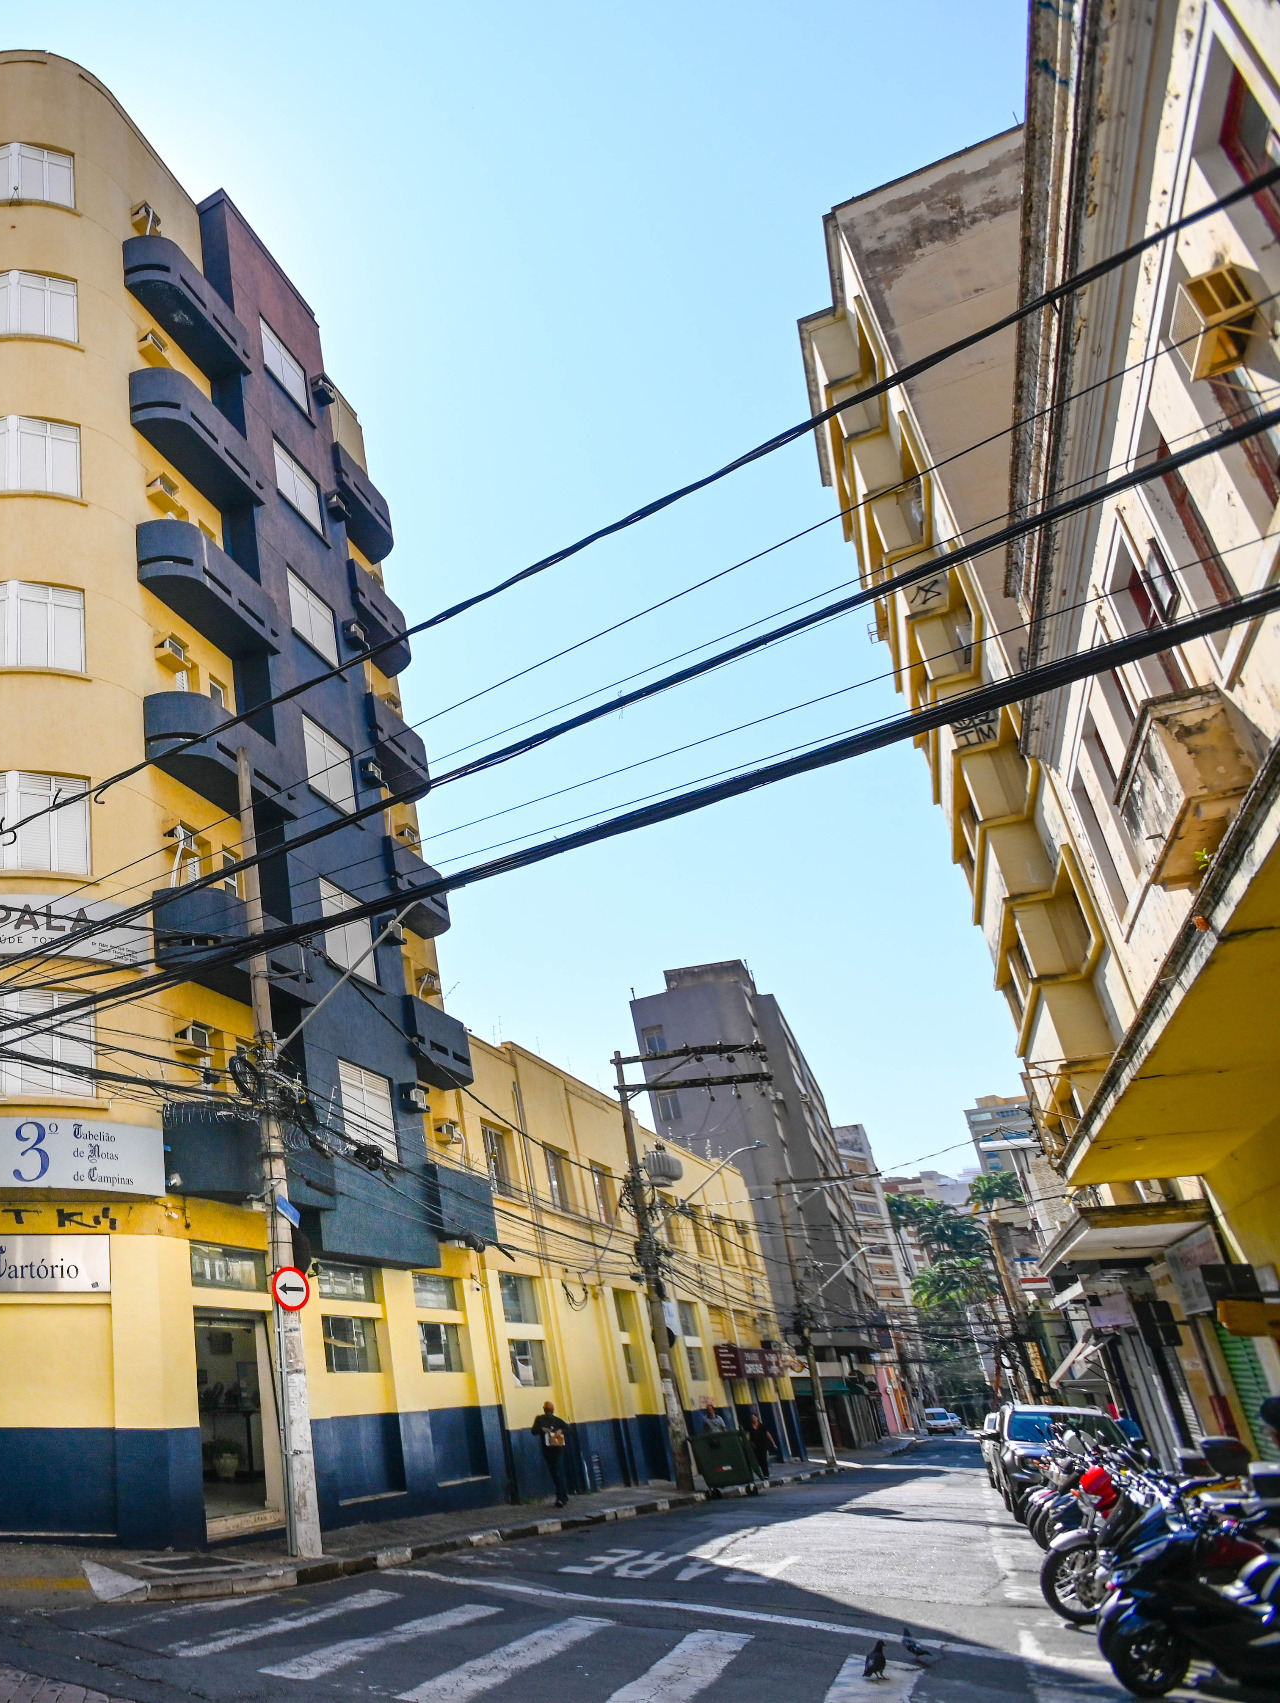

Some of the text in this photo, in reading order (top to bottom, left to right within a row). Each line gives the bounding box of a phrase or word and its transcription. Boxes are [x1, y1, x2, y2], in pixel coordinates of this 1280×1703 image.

[72, 1123, 116, 1143] Tabelião
[72, 1143, 119, 1163] de Notas
[72, 1166, 134, 1186] de Campinas
